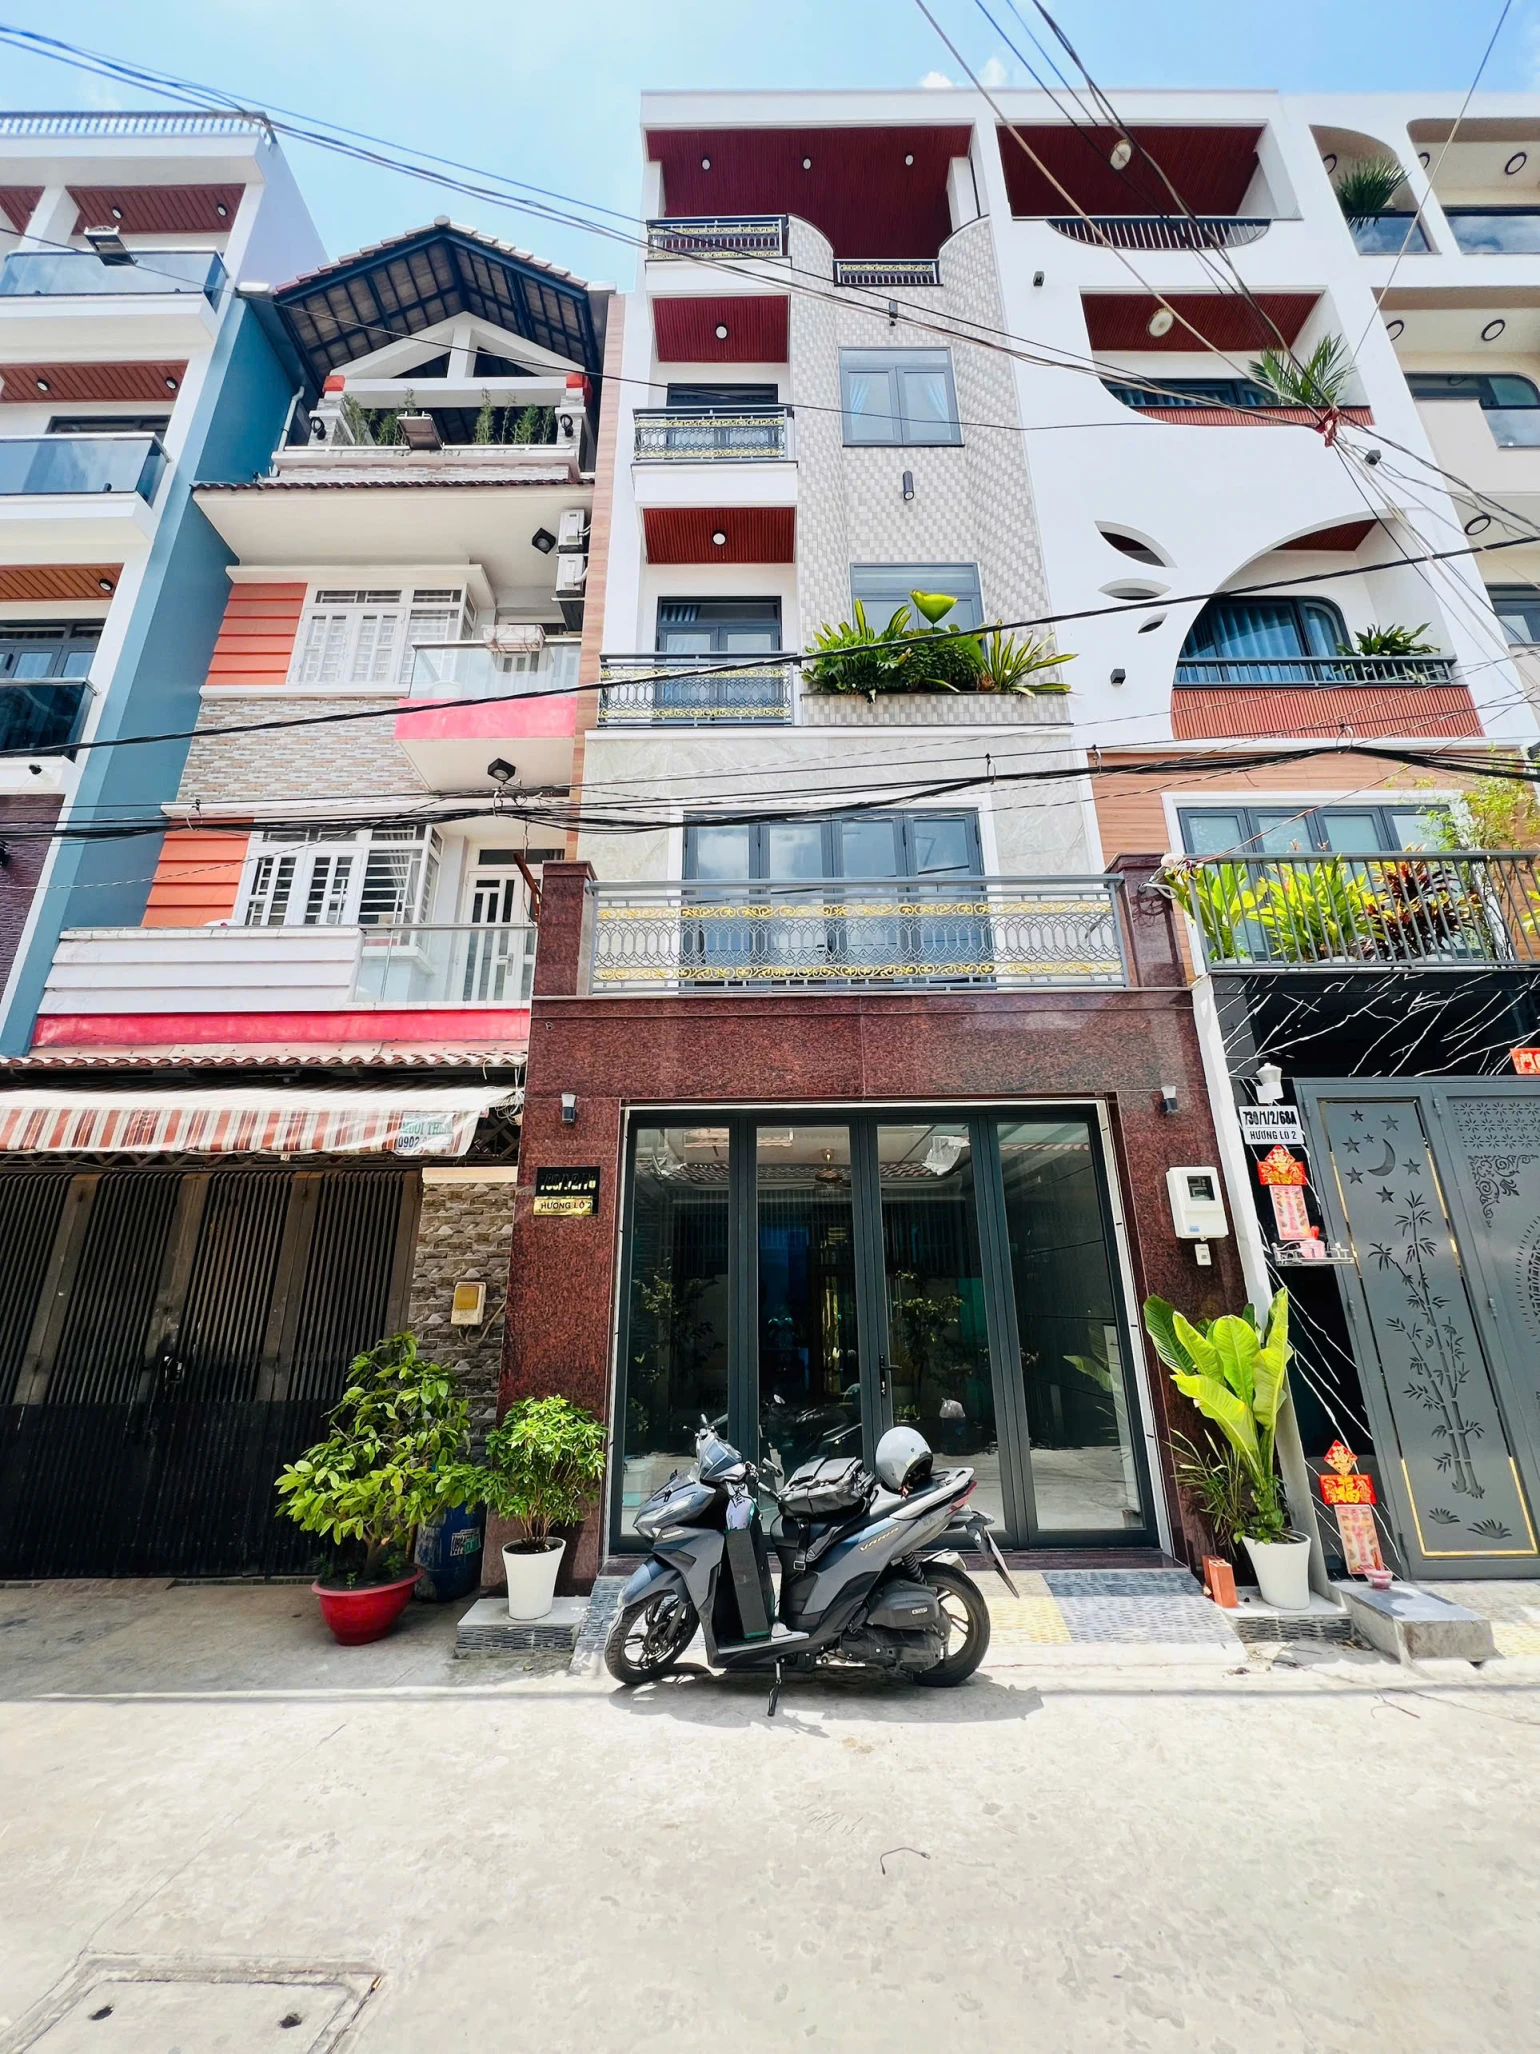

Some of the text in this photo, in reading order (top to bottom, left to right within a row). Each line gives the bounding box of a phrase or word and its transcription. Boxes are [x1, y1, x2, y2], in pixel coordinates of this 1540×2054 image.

[1243, 1110, 1297, 1125] 730/1/2/68A
[1249, 1130, 1278, 1140] HƯƠNG
[1291, 1130, 1297, 1140] 2
[398, 1136, 420, 1148] 0902
[540, 1200, 571, 1210] HƯƠNG
